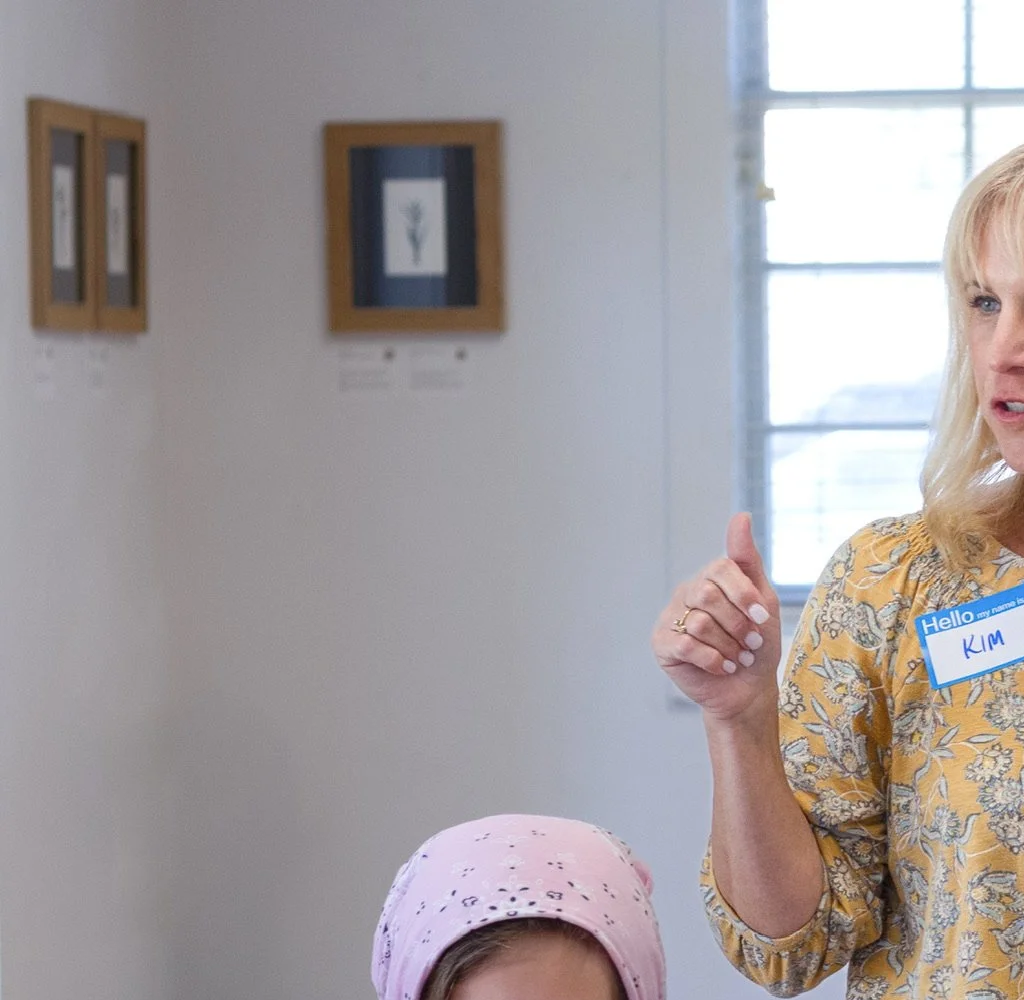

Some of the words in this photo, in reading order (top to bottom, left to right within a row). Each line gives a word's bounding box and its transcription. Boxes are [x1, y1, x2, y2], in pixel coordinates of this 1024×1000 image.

[921, 610, 974, 634] Hello
[976, 609, 991, 619] my
[991, 601, 1016, 613] name
[1016, 596, 1024, 605] is
[962, 629, 1005, 659] KIM
